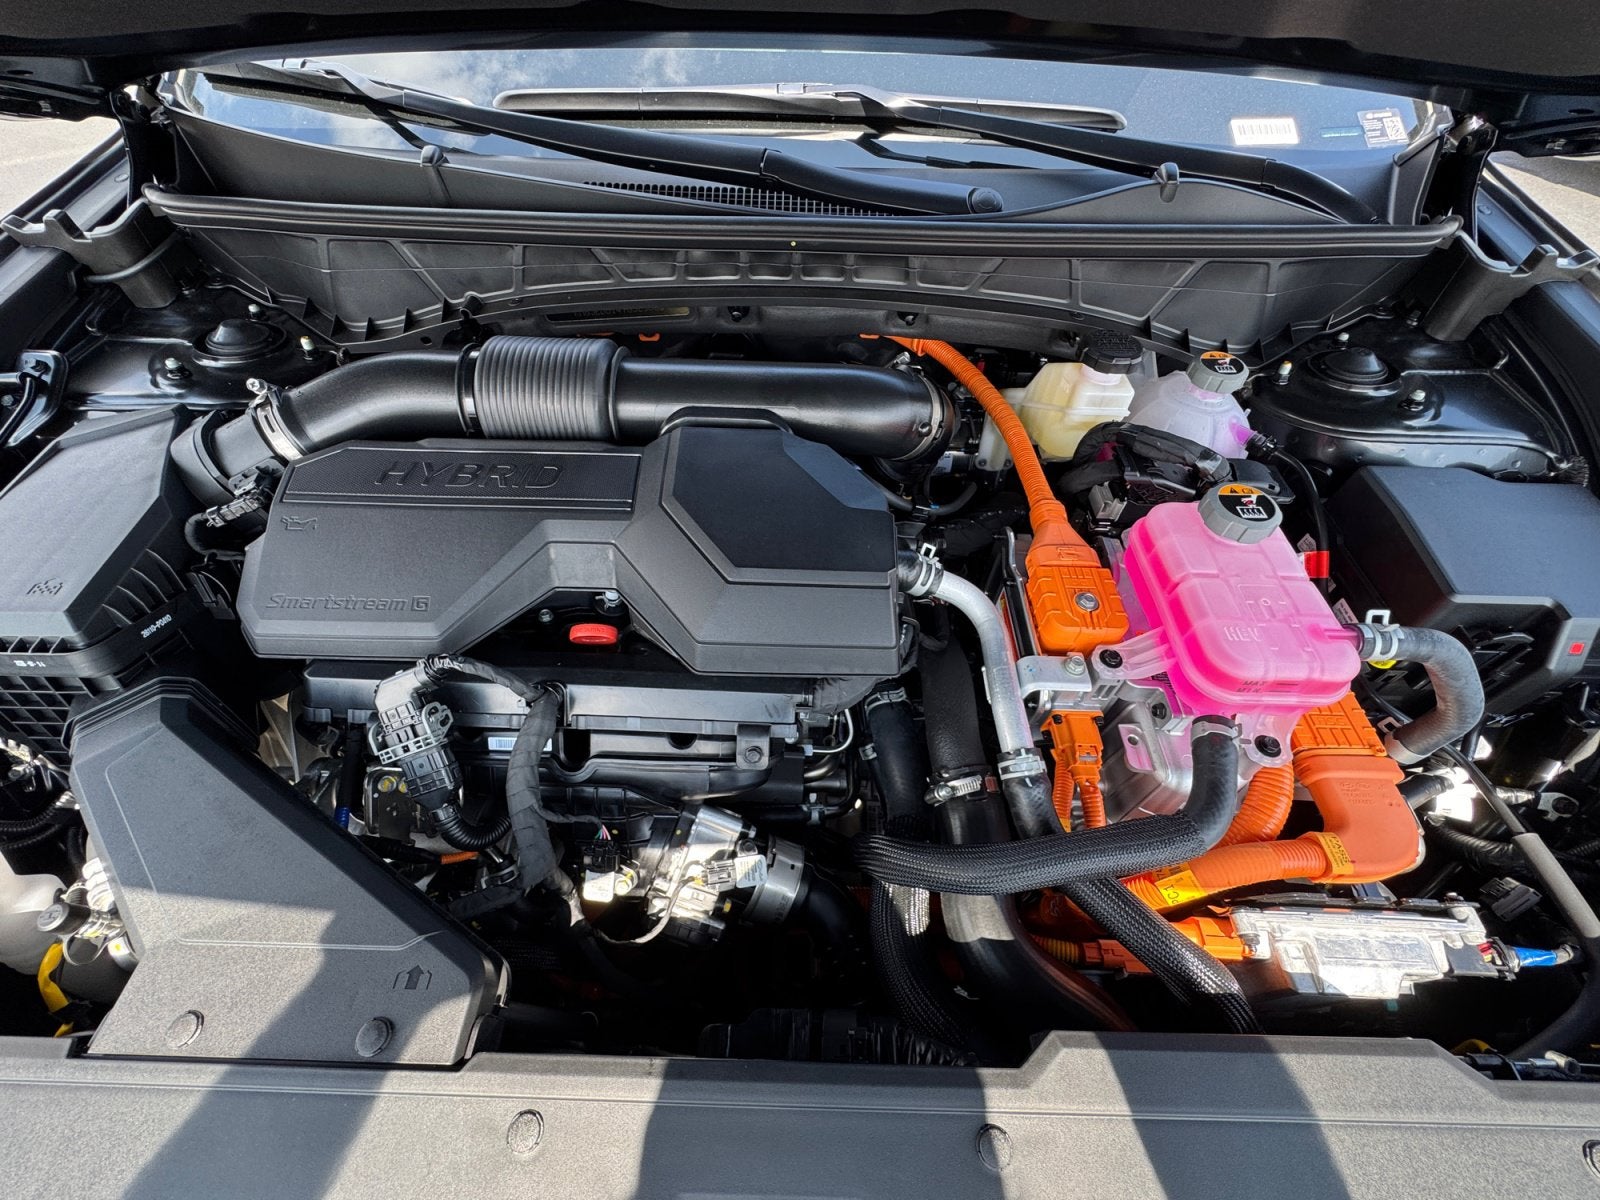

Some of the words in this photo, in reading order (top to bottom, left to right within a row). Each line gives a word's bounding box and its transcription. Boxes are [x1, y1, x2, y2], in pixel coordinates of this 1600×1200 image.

[374, 461, 564, 489] HYBRID
[265, 592, 409, 611] Smartstream
[411, 595, 431, 612] G
[1223, 626, 1262, 641] HEV
